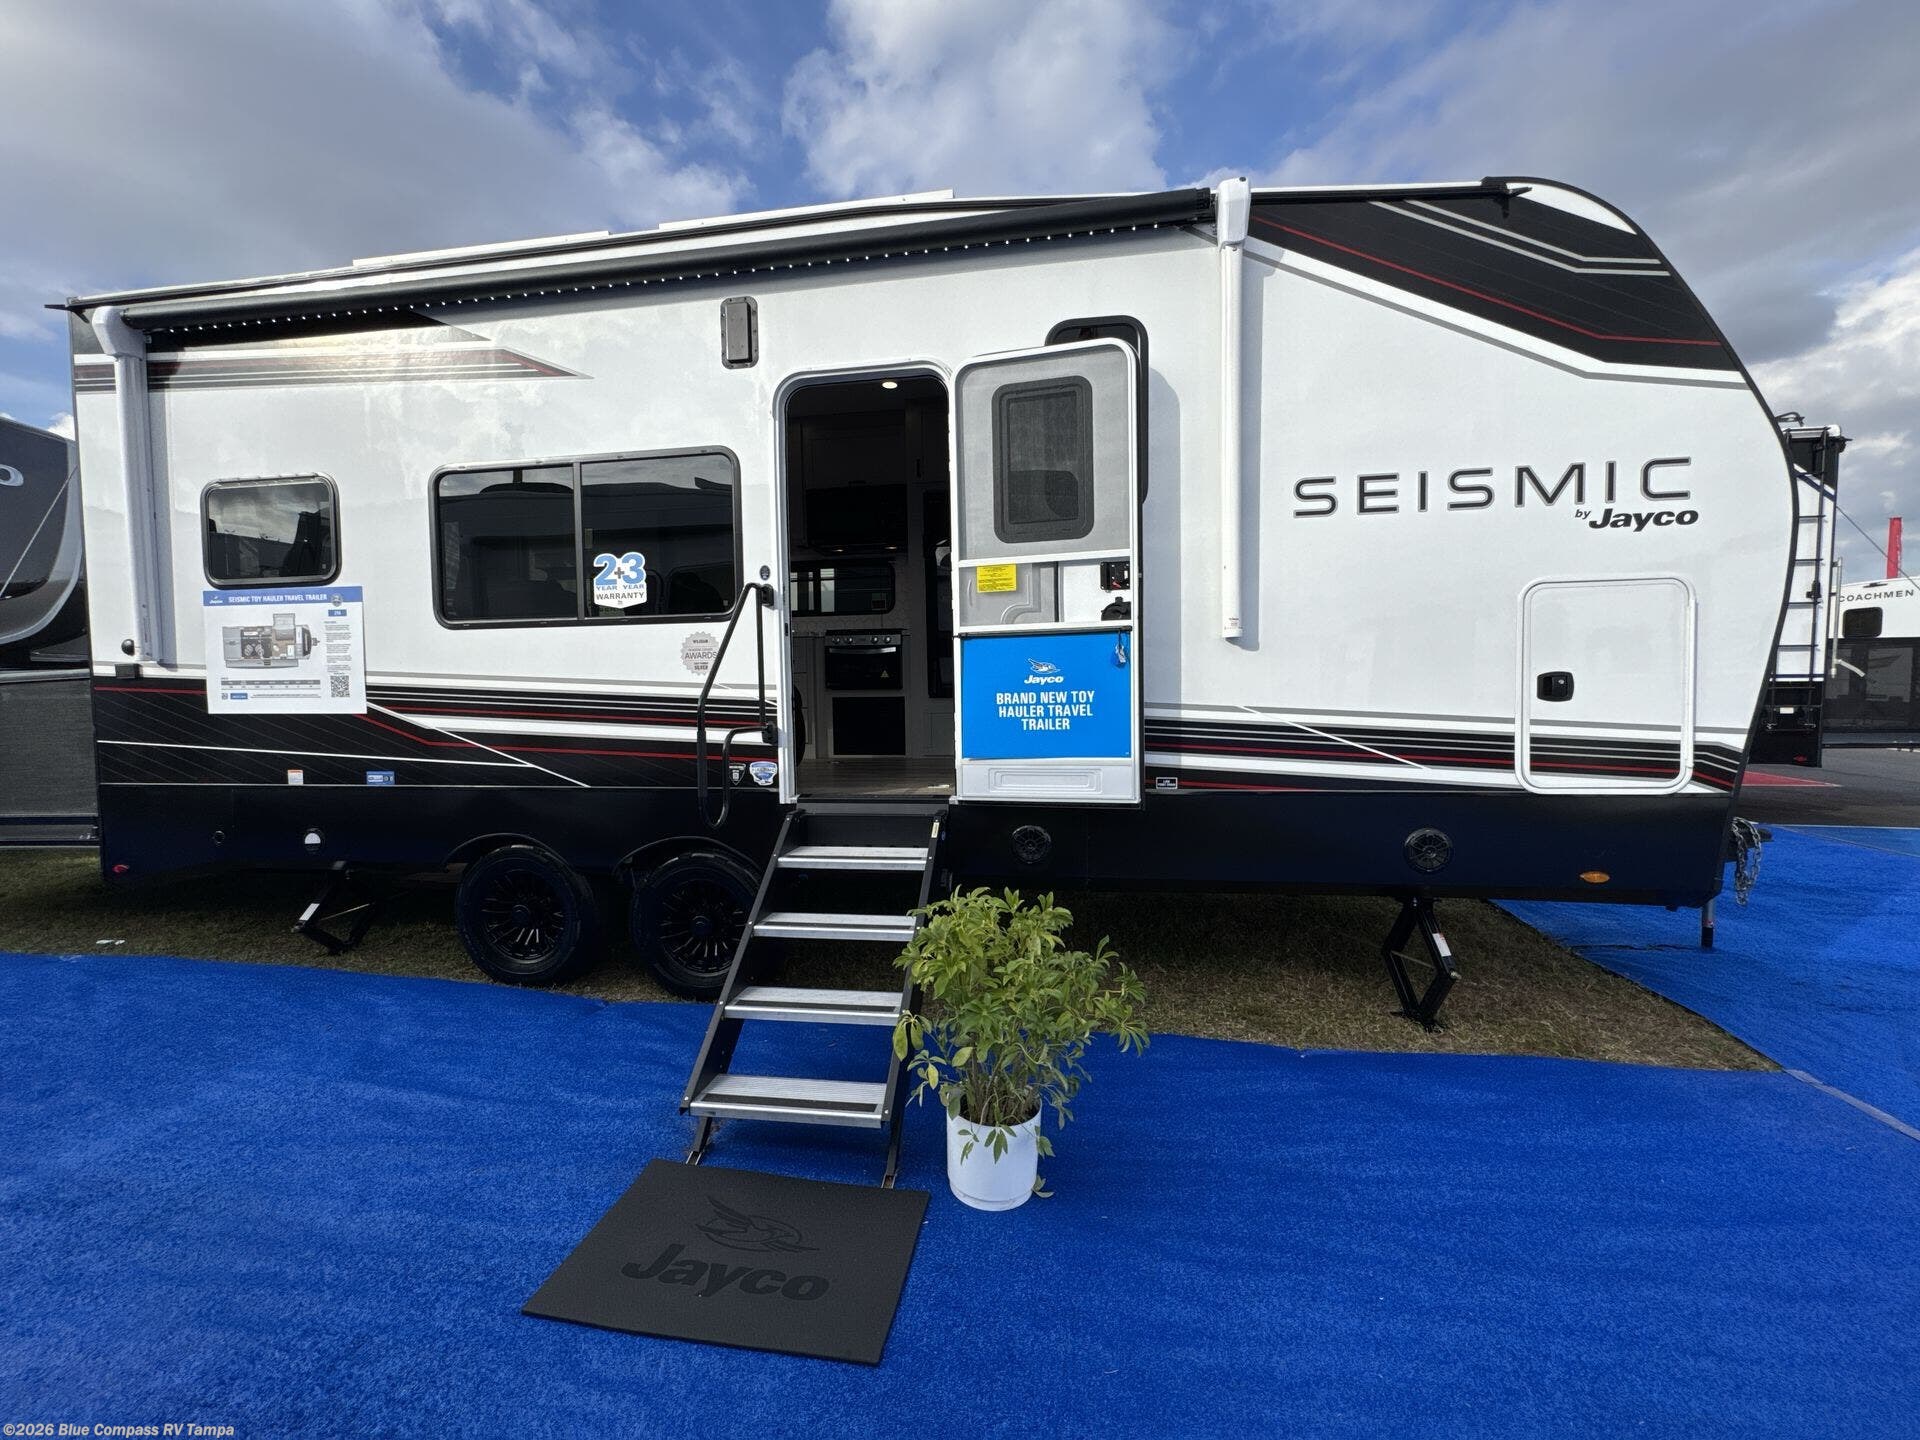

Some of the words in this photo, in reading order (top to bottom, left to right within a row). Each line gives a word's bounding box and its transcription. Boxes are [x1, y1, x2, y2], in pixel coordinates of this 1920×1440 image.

[1293, 456, 1692, 518] SEISMIC
[1575, 508, 1592, 520] by
[1588, 508, 1699, 533] Jayco
[596, 592, 645, 600] WARRANTY
[1839, 589, 1915, 602] COACHMEN
[685, 651, 719, 659] AWARDS
[1024, 675, 1064, 685] Jayco
[996, 692, 1037, 705] BRAND
[1040, 691, 1068, 704] NEW
[1071, 690, 1095, 703] TOY
[998, 705, 1045, 718] HAULER
[1047, 704, 1094, 717] TRAVEL
[1021, 718, 1071, 731] TRAILER
[621, 1243, 830, 1301] Jayco
